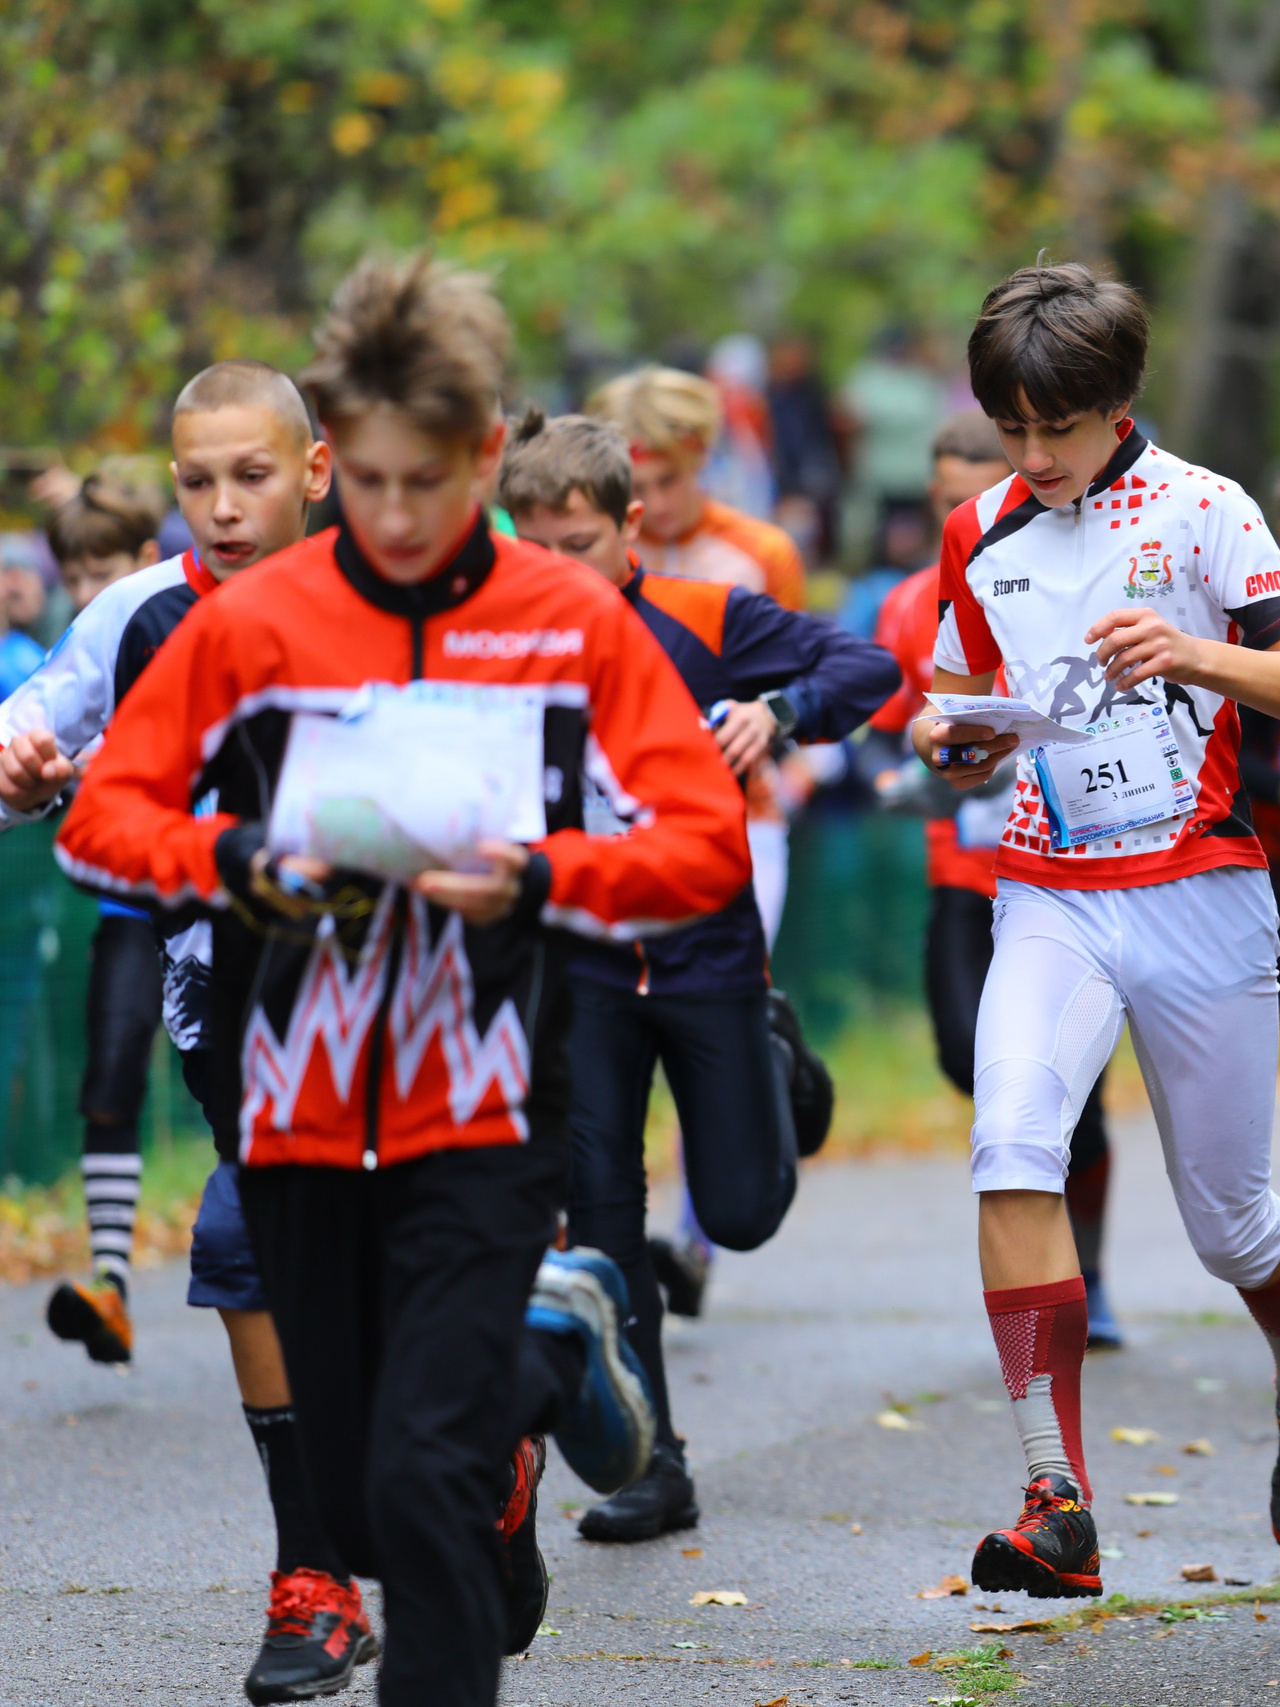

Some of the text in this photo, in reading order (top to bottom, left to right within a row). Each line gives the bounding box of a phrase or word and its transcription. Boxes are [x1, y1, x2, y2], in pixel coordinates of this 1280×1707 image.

[993, 578, 1030, 596] Storm
[1080, 759, 1131, 794] 251
[1112, 792, 1119, 801] 3
[1117, 812, 1165, 832] СОРЕВНОВАНИЯ
